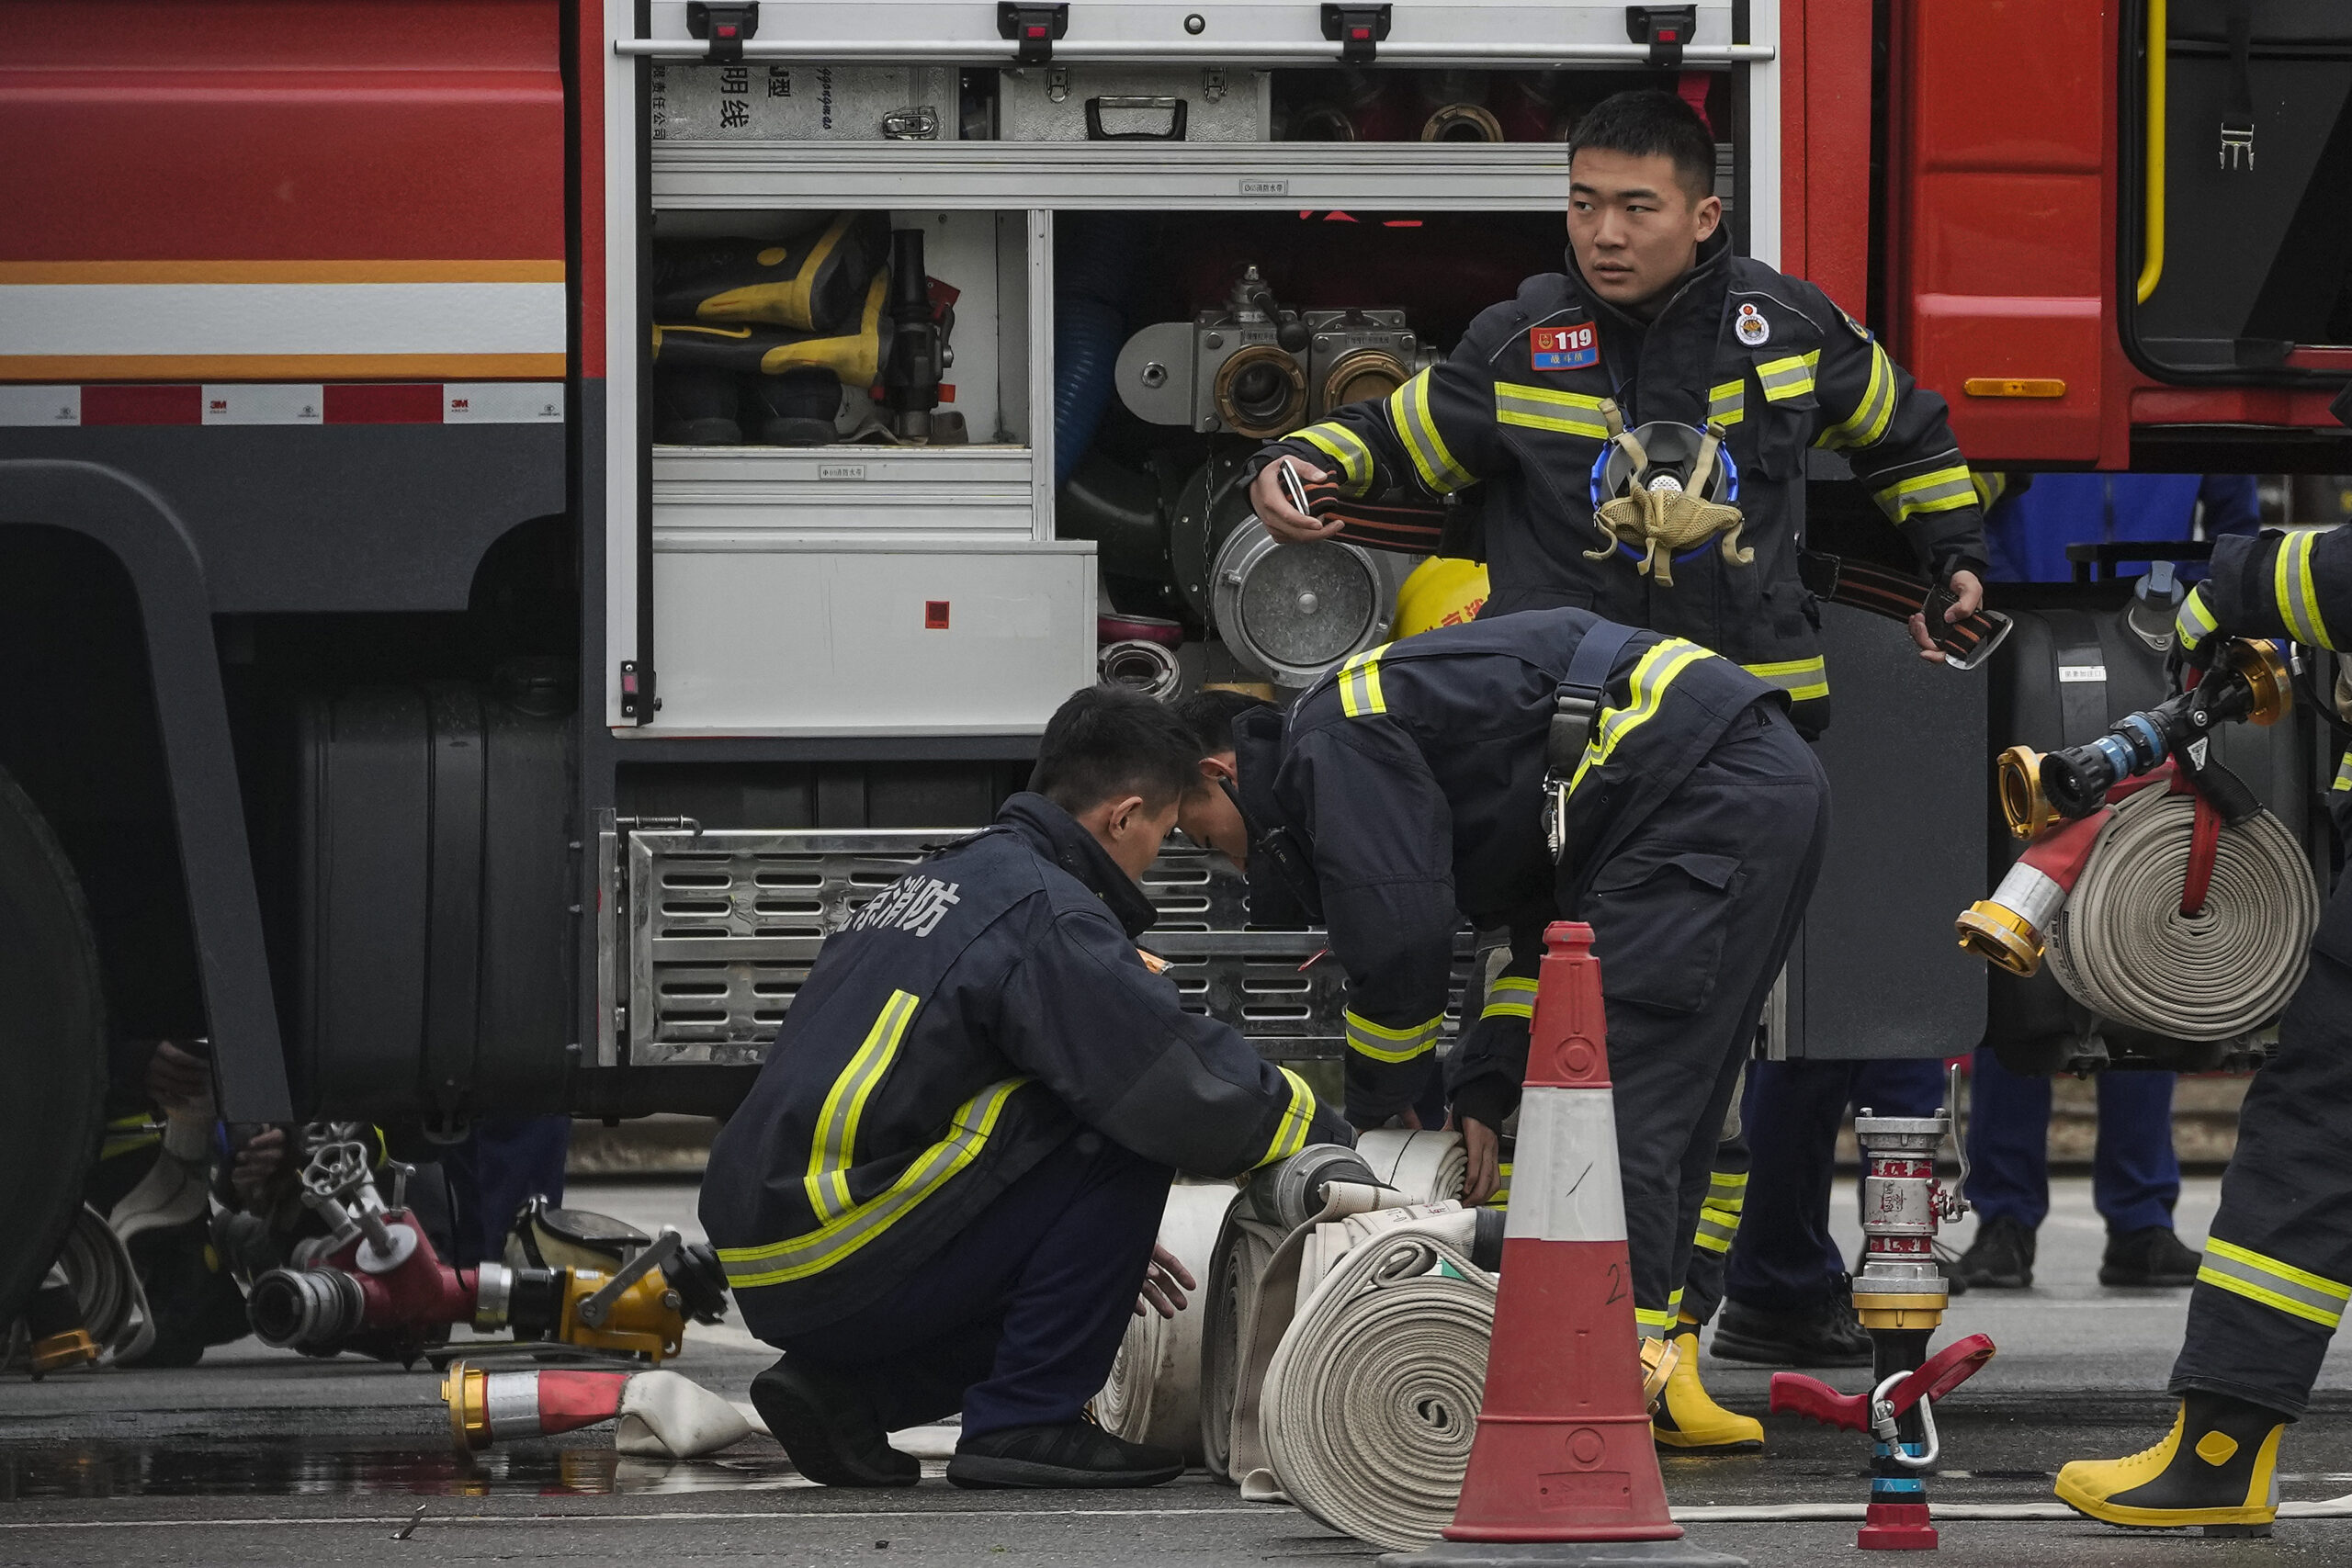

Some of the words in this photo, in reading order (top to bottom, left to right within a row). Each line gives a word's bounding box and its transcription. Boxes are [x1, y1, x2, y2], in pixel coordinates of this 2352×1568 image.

[1555, 328, 1592, 350] 119
[209, 400, 227, 409] 3M
[451, 400, 469, 408] 3M
